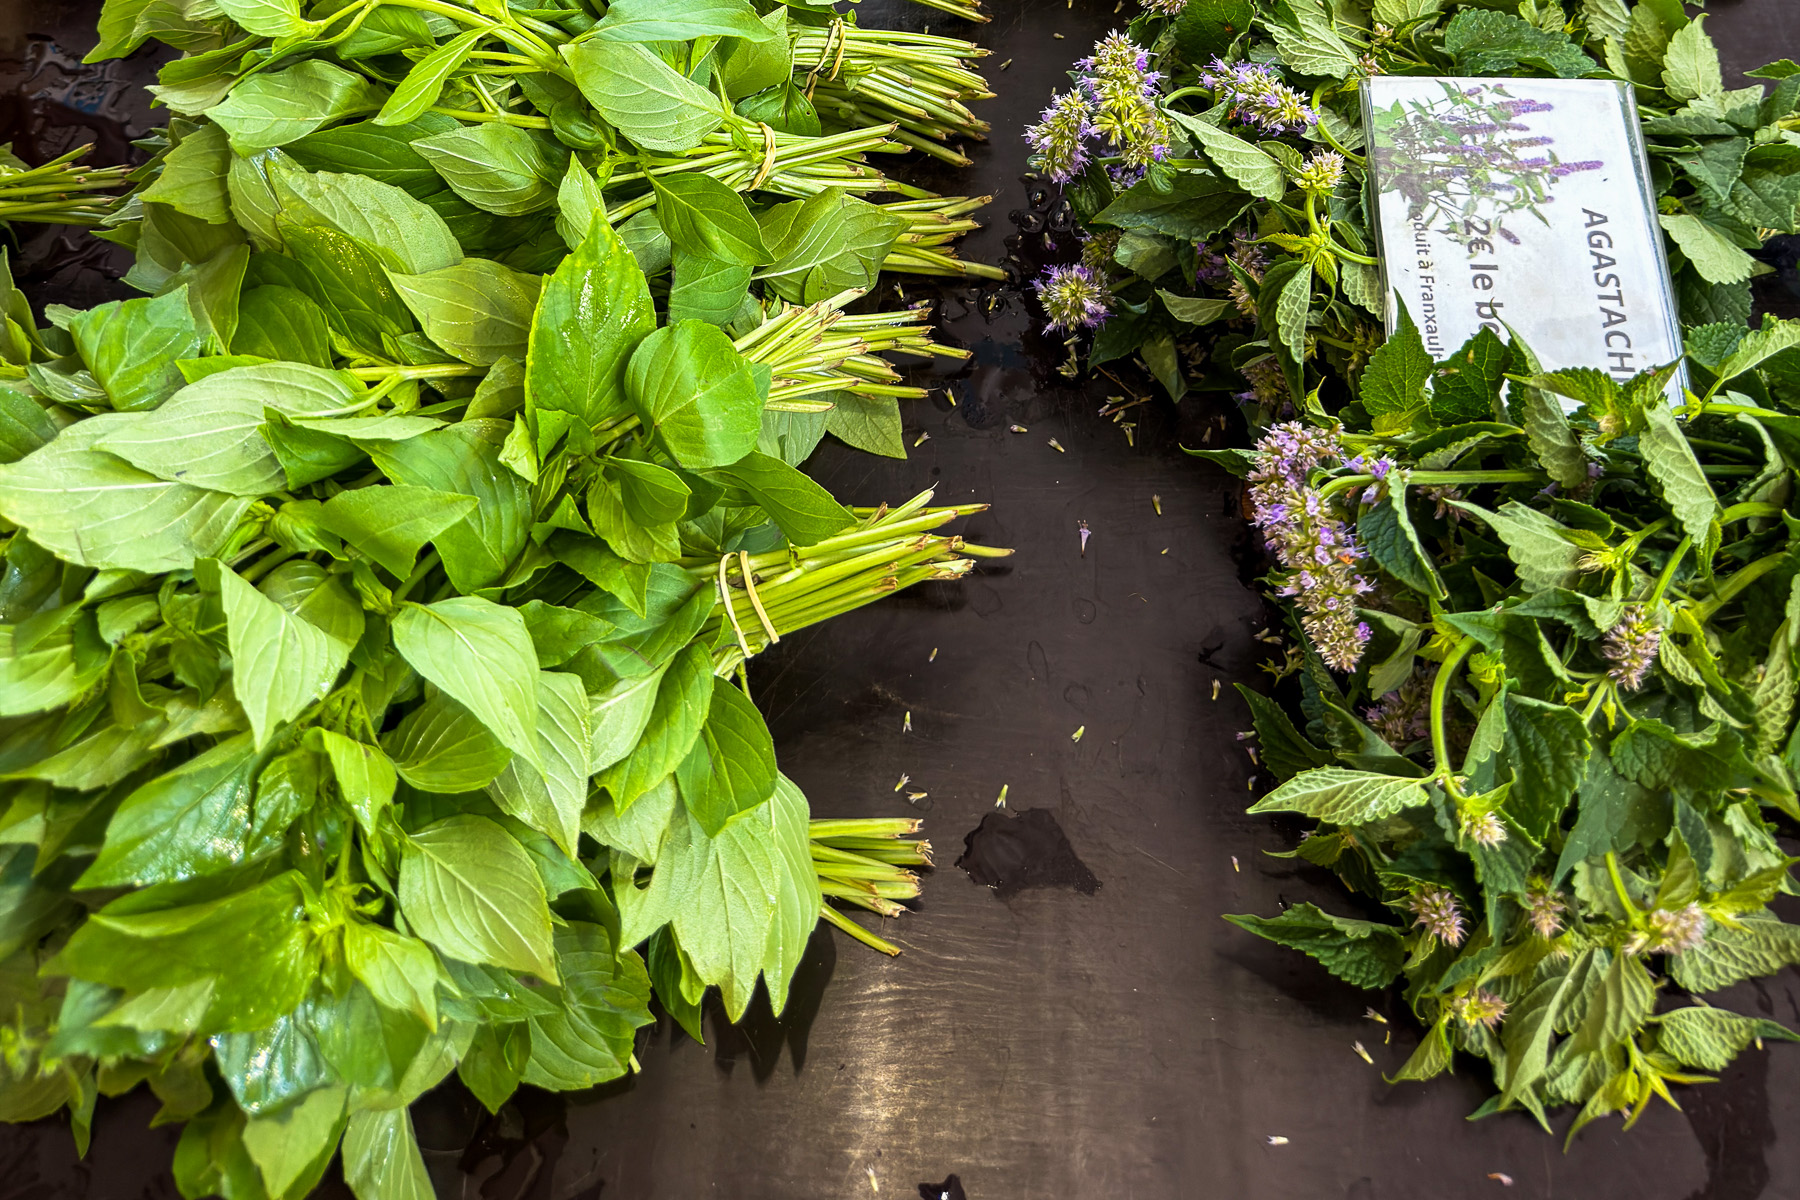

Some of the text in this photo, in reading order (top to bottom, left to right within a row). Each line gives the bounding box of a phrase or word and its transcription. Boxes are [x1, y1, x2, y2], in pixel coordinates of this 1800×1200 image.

[1464, 218, 1495, 255] 2€
[1411, 202, 1445, 360] roduit à Franxault
[1469, 263, 1499, 291] le
